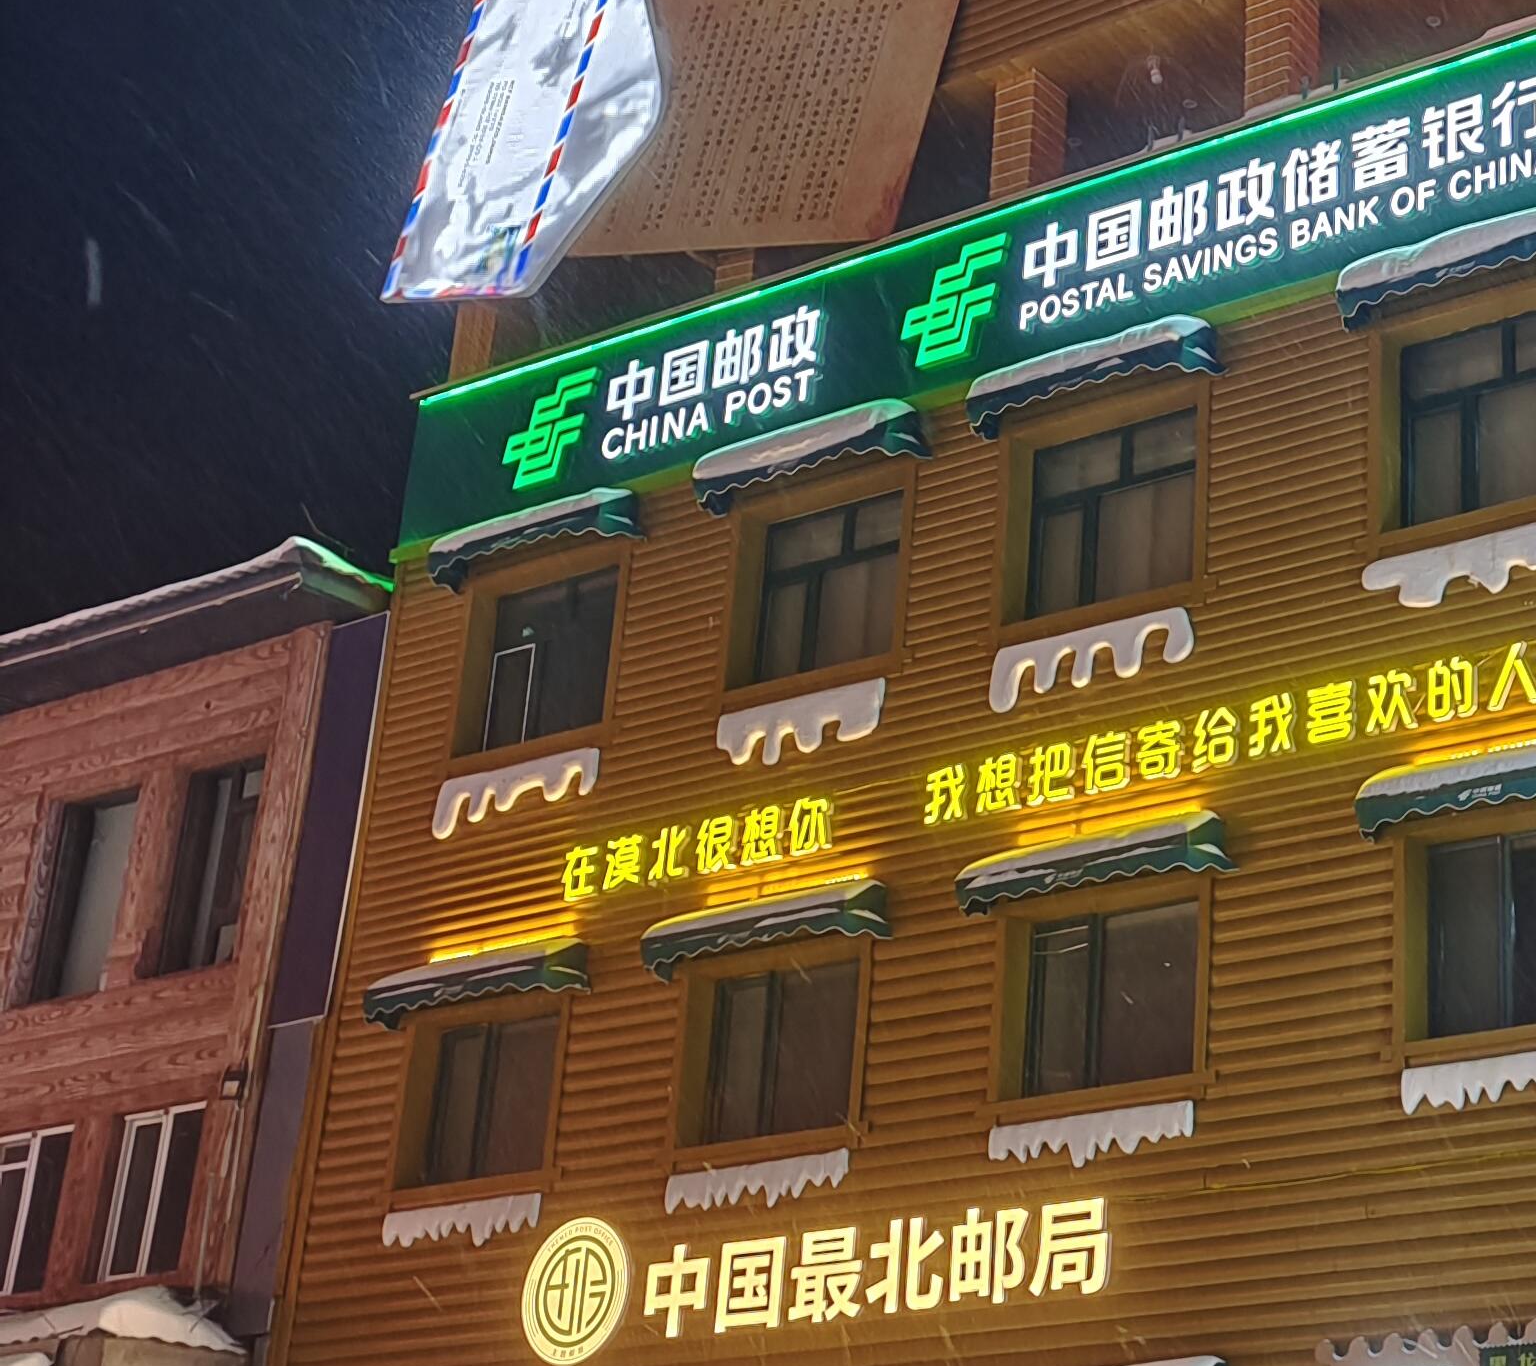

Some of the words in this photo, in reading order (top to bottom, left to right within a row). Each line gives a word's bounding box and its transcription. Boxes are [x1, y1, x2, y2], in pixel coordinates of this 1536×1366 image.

[1017, 274, 1135, 331] POSTAL
[1142, 229, 1279, 294] SAVINGS
[1289, 201, 1379, 254] BANK
[1390, 180, 1437, 218] OF
[600, 402, 710, 460] CHINA
[724, 369, 817, 424] POST
[606, 305, 821, 420] 中国邮政
[560, 797, 832, 903] 在漠北很想你
[642, 1196, 1112, 1340] 中国最北邮局
